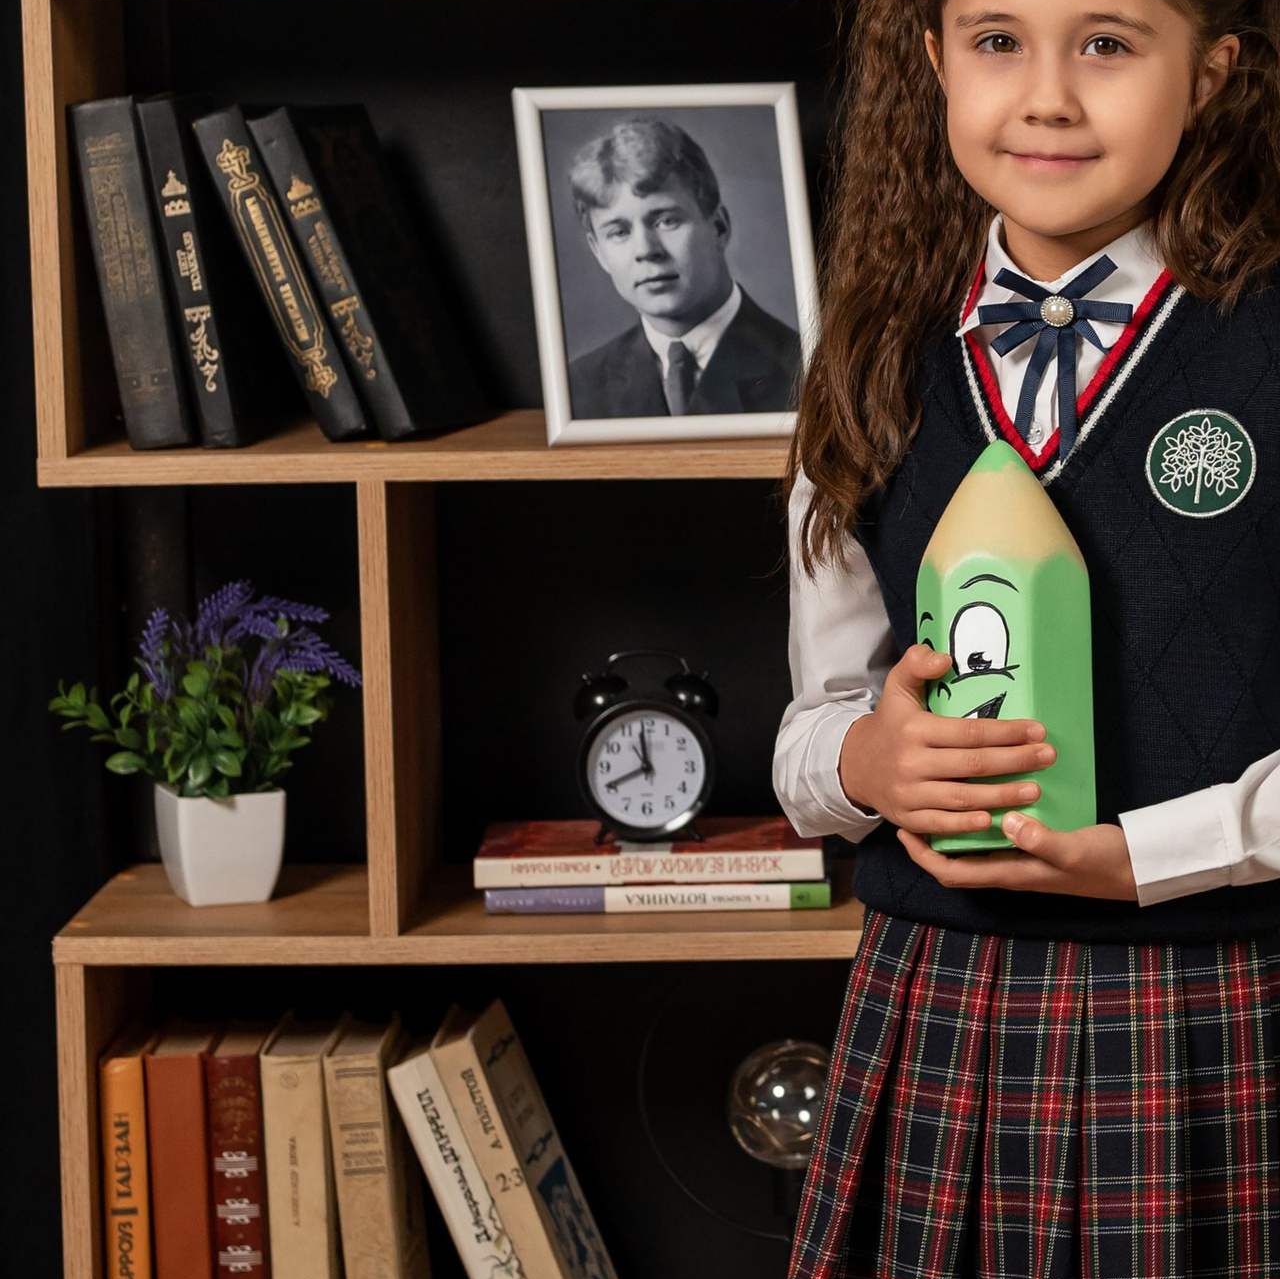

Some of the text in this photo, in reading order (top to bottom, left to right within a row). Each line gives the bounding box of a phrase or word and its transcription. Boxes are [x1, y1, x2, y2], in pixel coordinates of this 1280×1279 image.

[664, 723, 671, 737] 1
[606, 741, 621, 755] 10
[676, 737, 687, 751] 2
[599, 760, 611, 775] 9
[684, 760, 696, 774] 3
[677, 780, 688, 794] 4
[621, 796, 632, 812] 7
[641, 801, 653, 816] 6
[664, 794, 675, 809] 5
[609, 856, 658, 879] ЛЮДЕЙ
[660, 857, 725, 876] ВЕЛИКИХ
[625, 892, 707, 906] БОТАНИКА
[460, 1067, 496, 1136] ТОЛСТОЙ
[112, 1112, 132, 1201] ТАРЗАН
